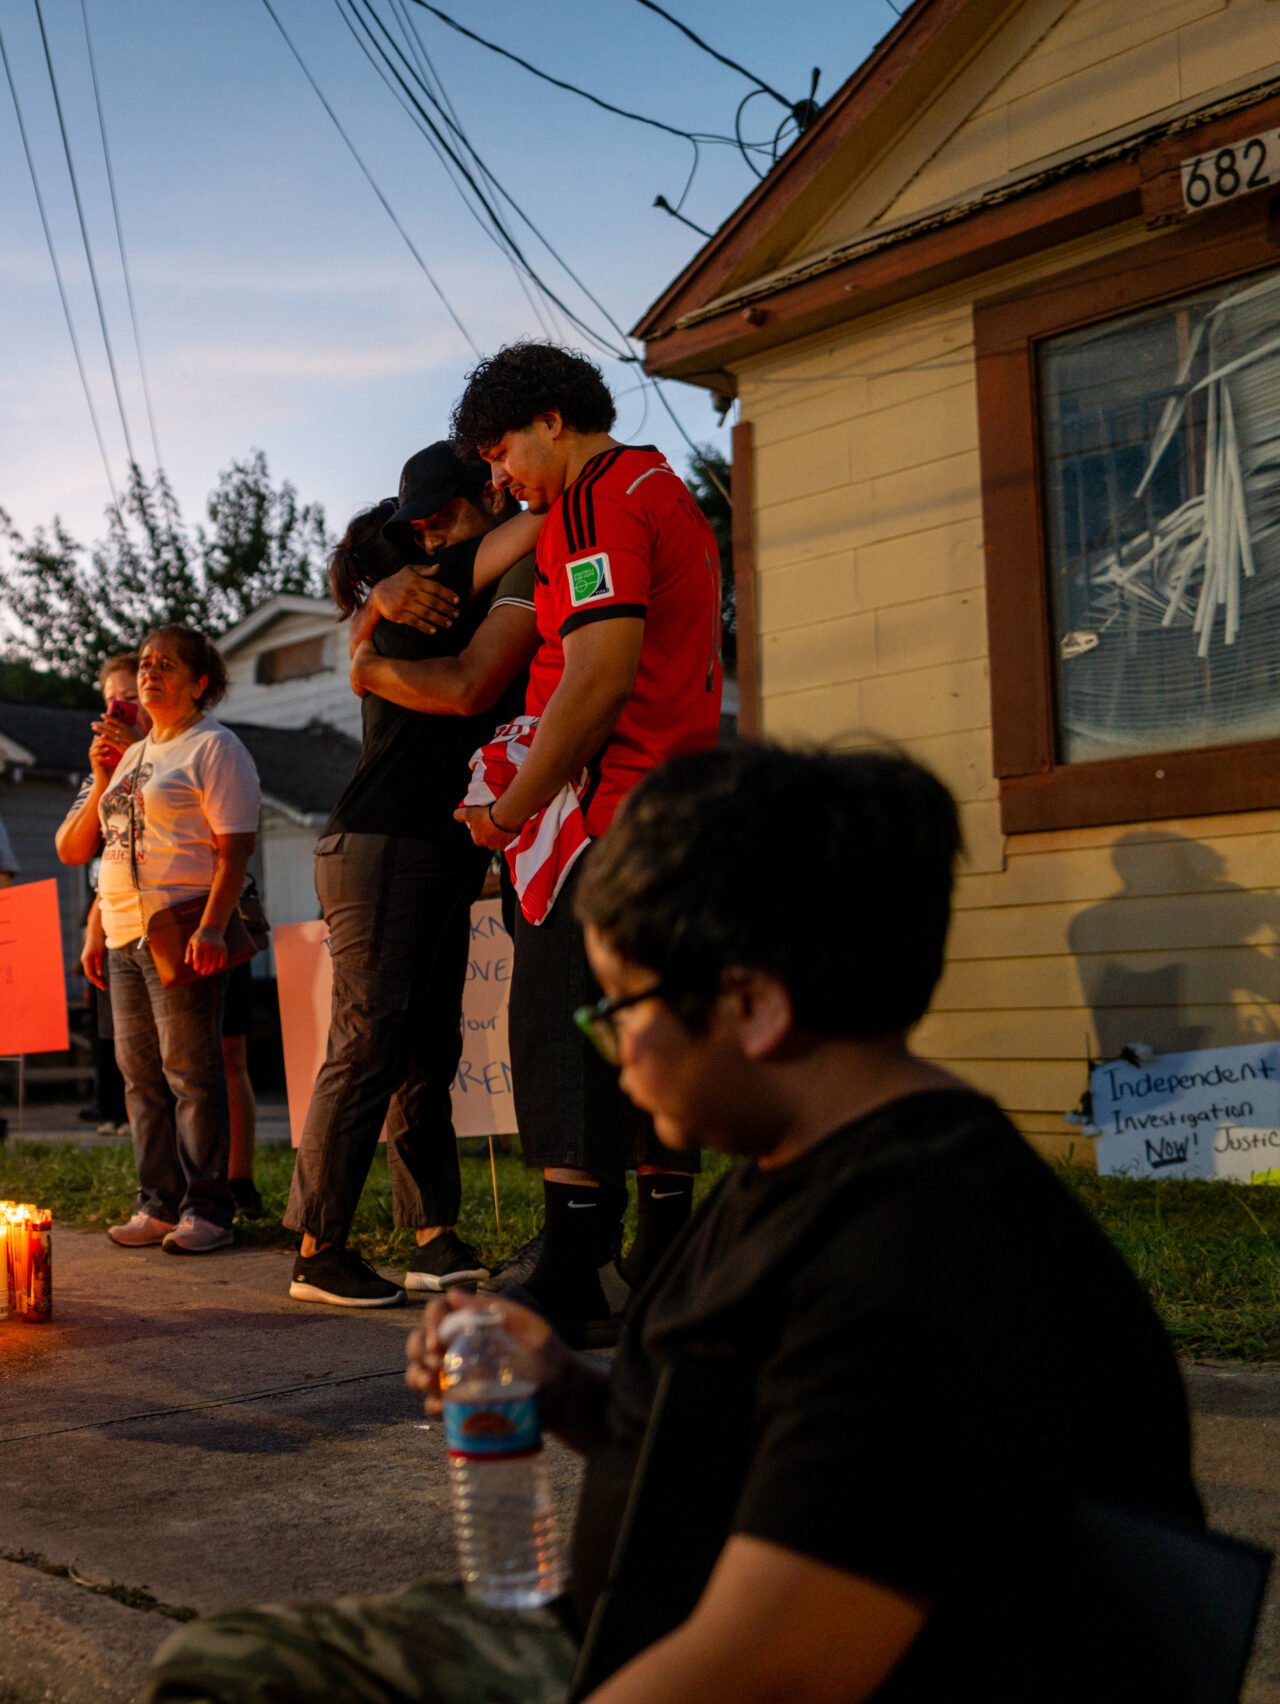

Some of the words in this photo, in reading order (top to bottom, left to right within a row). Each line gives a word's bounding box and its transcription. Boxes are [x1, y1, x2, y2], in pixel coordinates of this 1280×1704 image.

[1186, 134, 1280, 208] 682
[1104, 1058, 1275, 1102] Independent
[1111, 1097, 1254, 1134] Investigation
